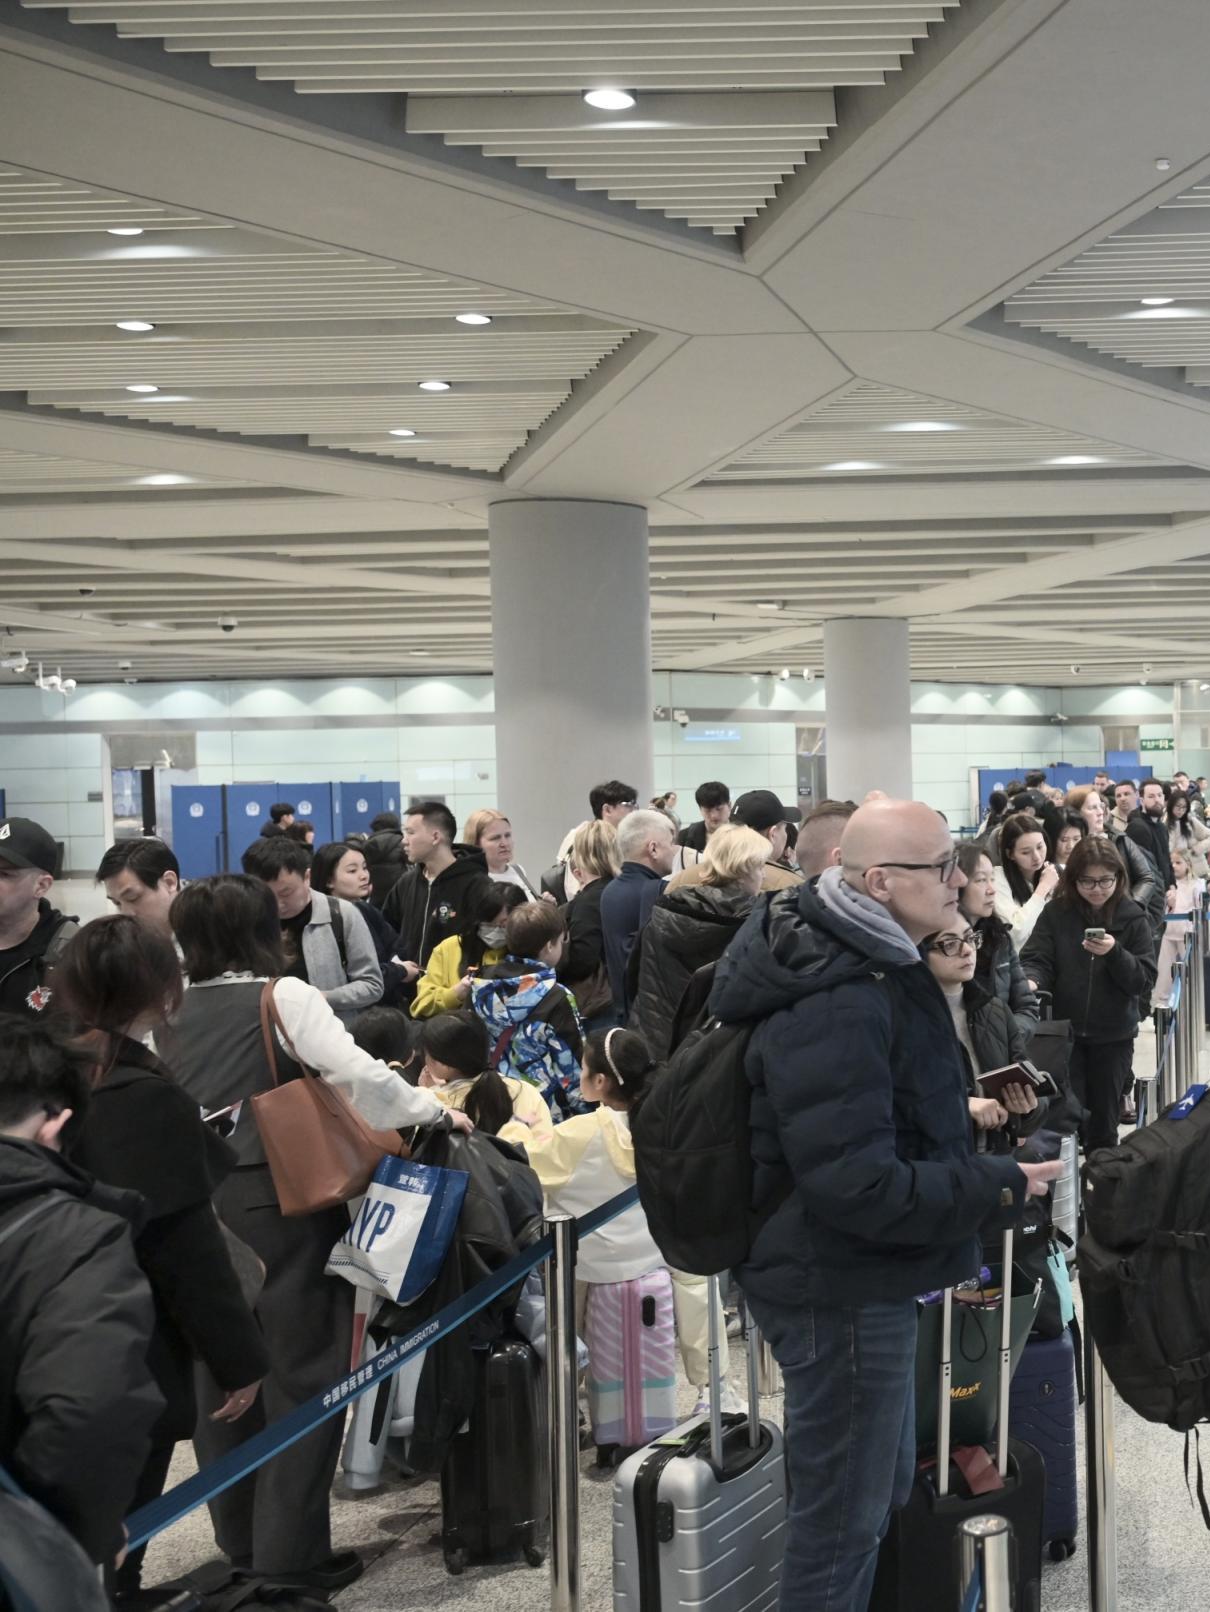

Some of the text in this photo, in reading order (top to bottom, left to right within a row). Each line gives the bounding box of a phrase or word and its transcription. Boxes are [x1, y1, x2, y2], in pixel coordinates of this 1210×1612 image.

[377, 1320, 439, 1370] CHINA IMMIGRATION
[323, 1364, 373, 1408] 中国移民管理
